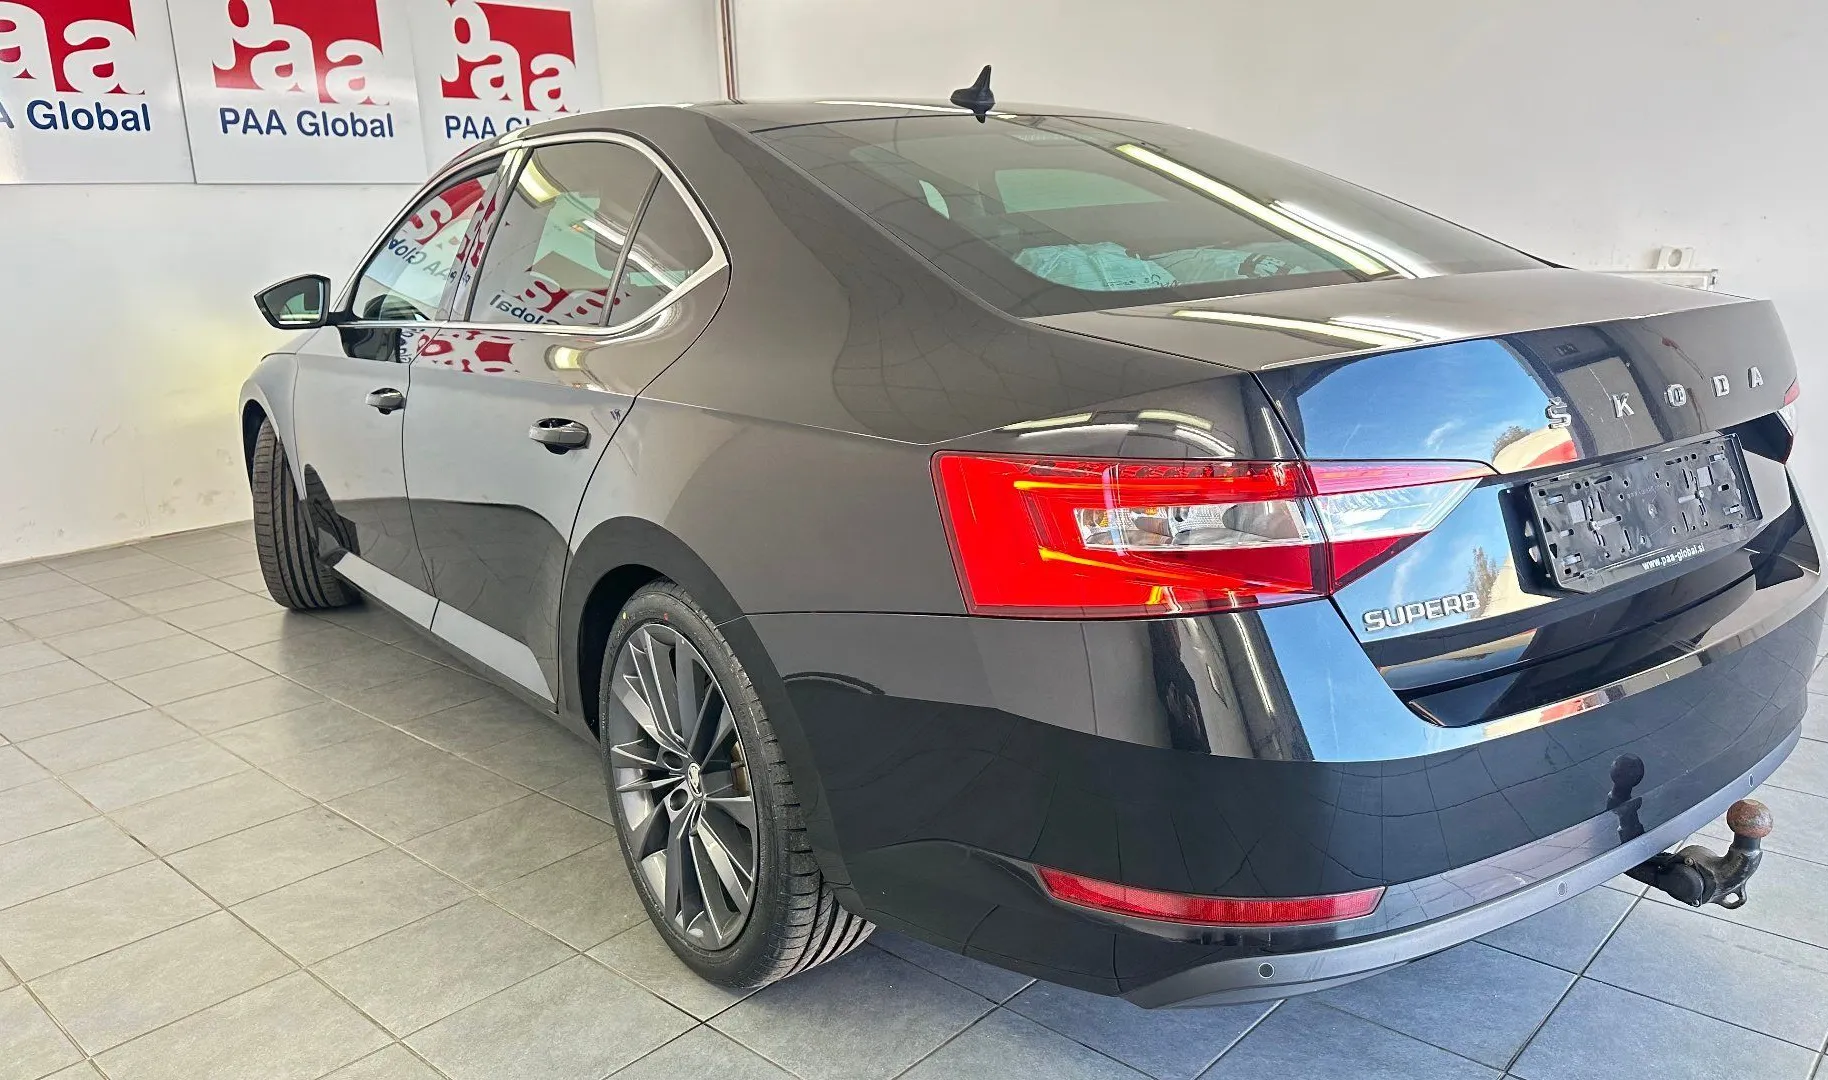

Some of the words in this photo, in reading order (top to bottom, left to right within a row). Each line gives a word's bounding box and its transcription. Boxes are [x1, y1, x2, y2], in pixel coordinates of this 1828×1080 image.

[440, 0, 581, 112] paa
[27, 99, 151, 131] Global
[219, 107, 287, 136] PAA
[296, 110, 394, 138] Global
[444, 115, 497, 139] PAA
[1642, 542, 1706, 570] www.paa-global.si
[1362, 592, 1480, 632] SUPERB
